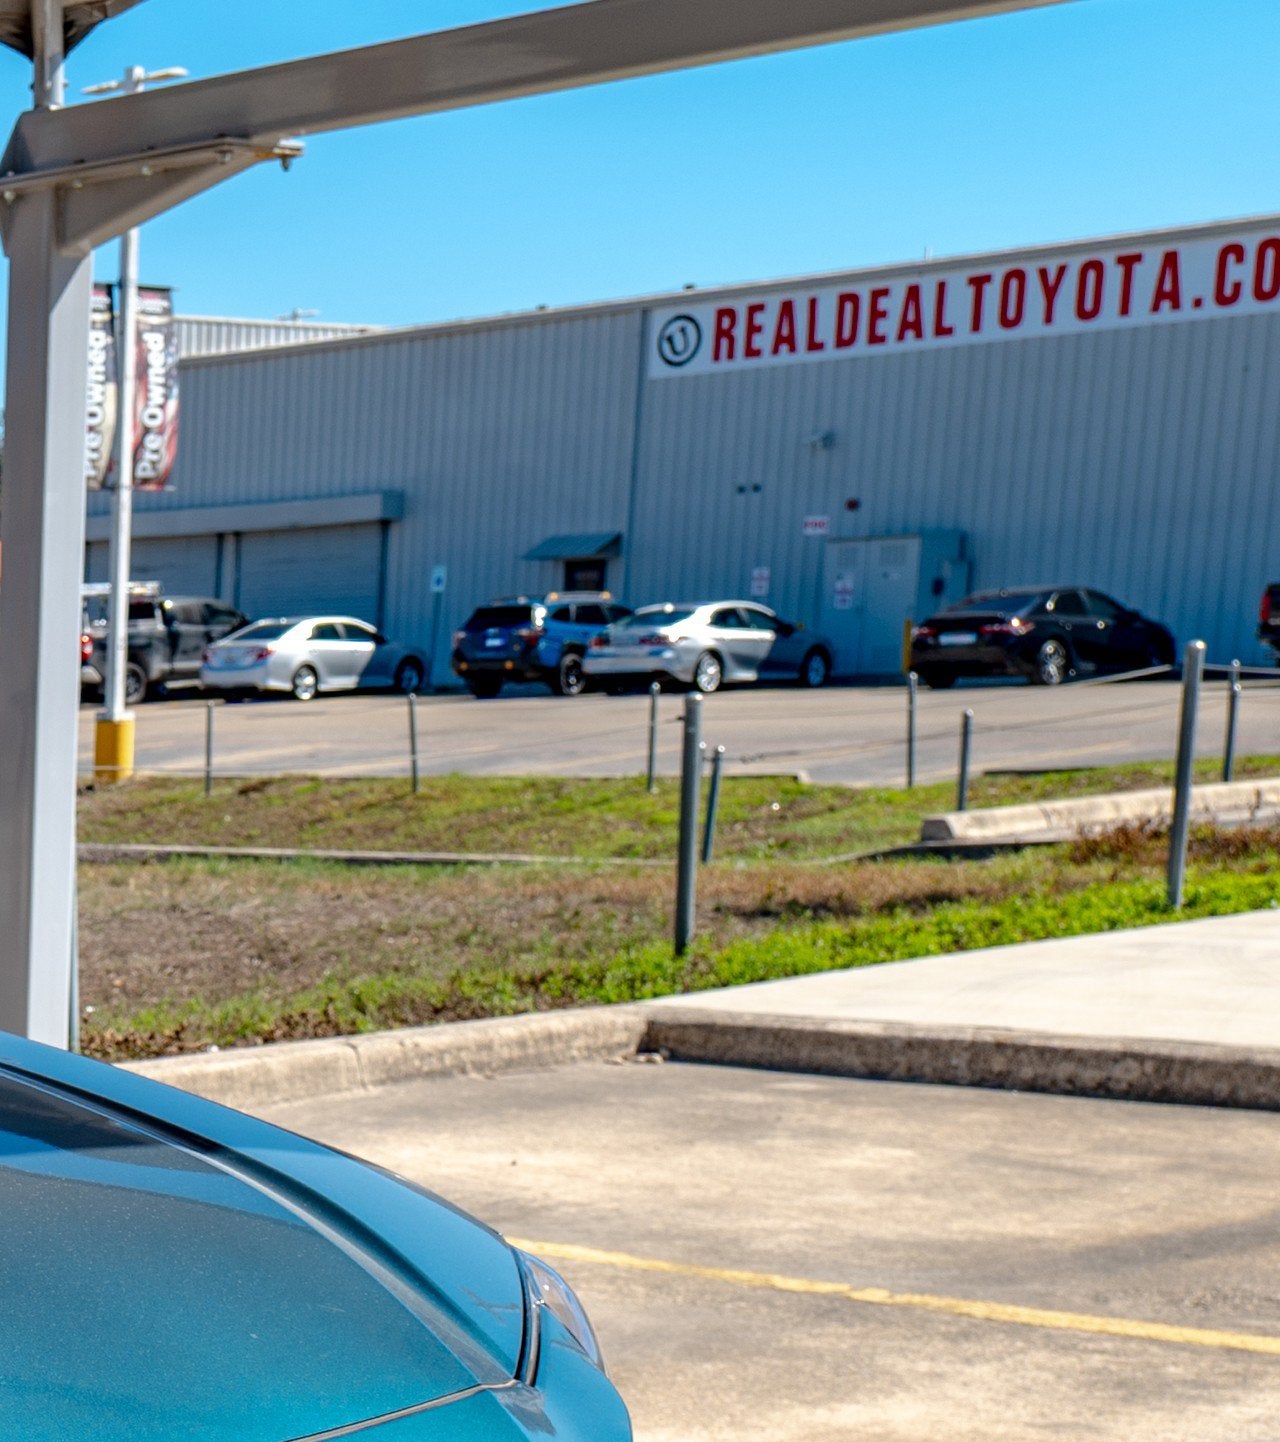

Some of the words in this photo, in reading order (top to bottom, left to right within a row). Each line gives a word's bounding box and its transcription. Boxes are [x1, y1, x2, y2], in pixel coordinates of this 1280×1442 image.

[712, 237, 1280, 362] REALDEALTOYOTA.CO
[141, 331, 165, 430] Owned
[134, 431, 163, 480] Pre
